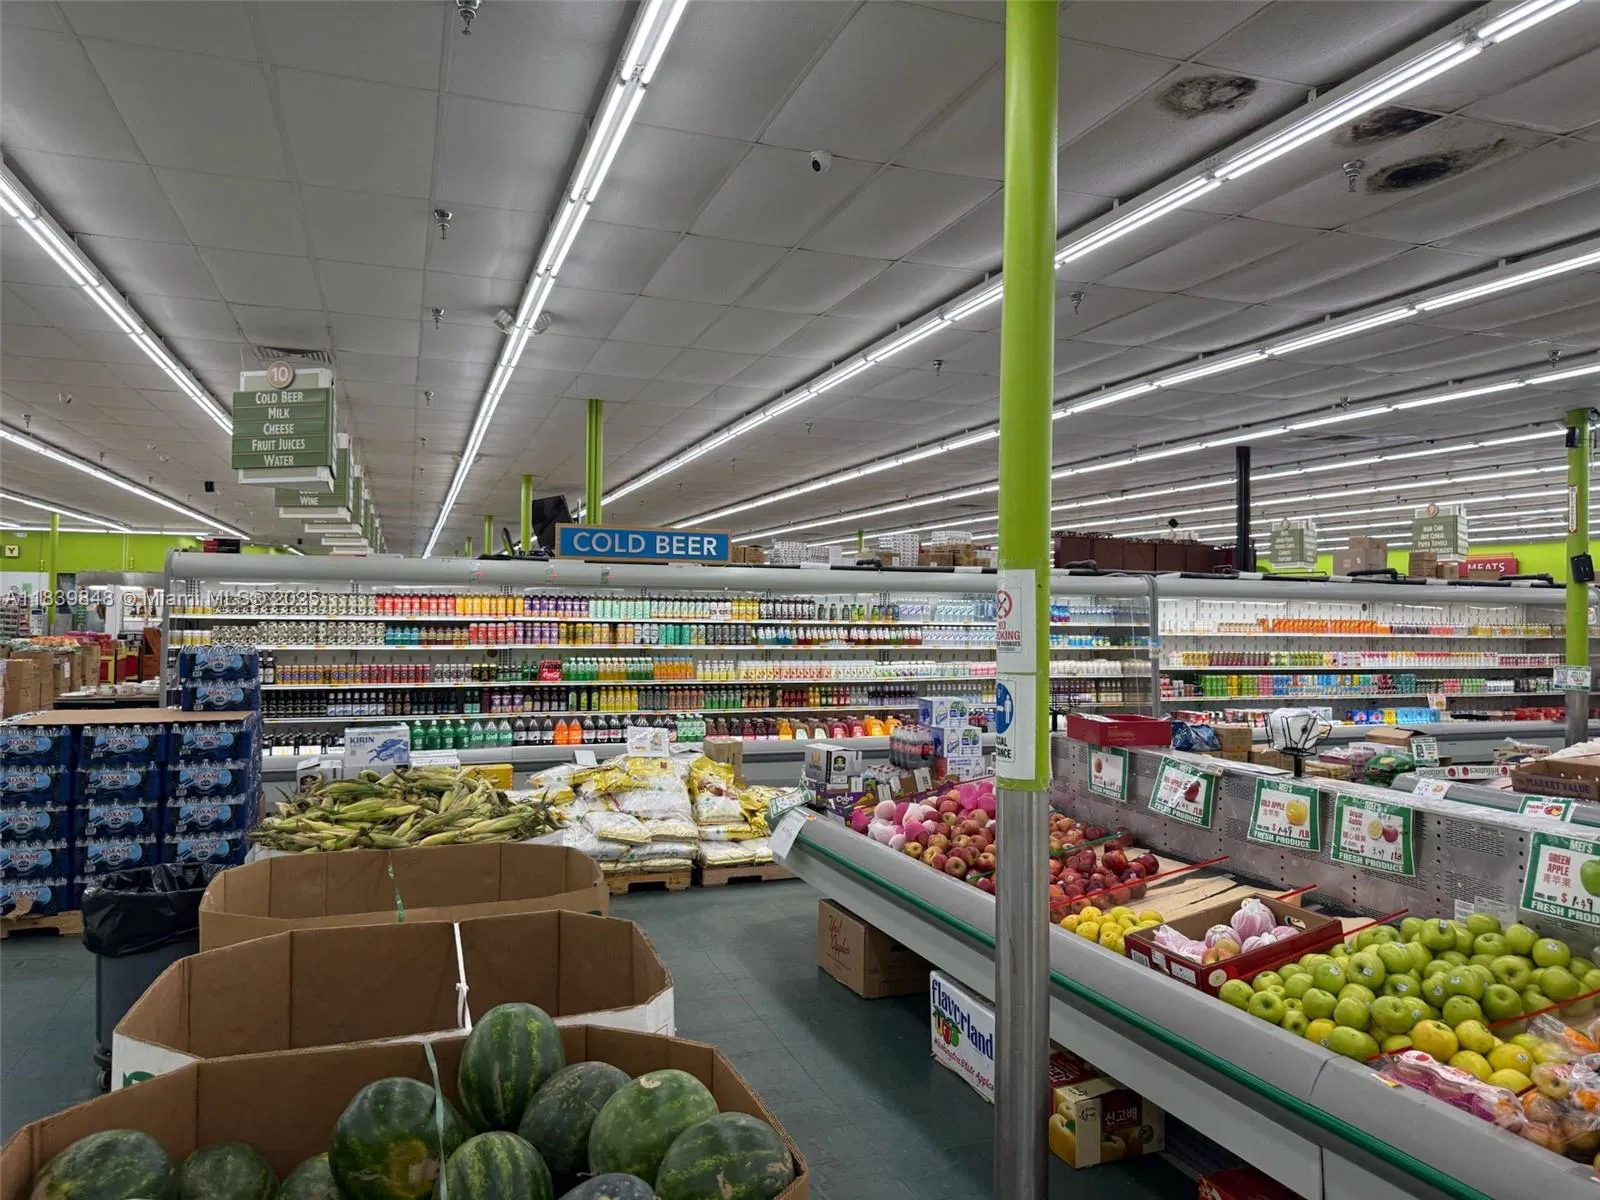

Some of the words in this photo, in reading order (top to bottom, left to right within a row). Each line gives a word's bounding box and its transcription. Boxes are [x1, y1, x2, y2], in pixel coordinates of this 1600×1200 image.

[271, 367, 288, 381] 10
[255, 393, 278, 405] COLD
[281, 391, 304, 403] BEER
[268, 408, 290, 419] MILK
[263, 423, 294, 435] CHEESE
[252, 439, 275, 451] FRUIT
[278, 438, 305, 451] JUICES
[263, 454, 294, 467] WATER
[300, 495, 319, 505] WINE
[573, 532, 646, 553] COLD
[656, 535, 717, 556] BEER
[1467, 562, 1505, 572] MEATS
[349, 736, 376, 744] KIRIN
[1172, 809, 1202, 824] PRODUCE
[1254, 831, 1274, 842] FRESH
[1275, 835, 1311, 848] PRODUCE
[1568, 840, 1594, 854] MEI'S
[1339, 852, 1363, 865] FRESH
[1365, 858, 1404, 873] PRODUCE
[1548, 852, 1571, 866] GREEN
[1547, 863, 1570, 877] APPLE
[1561, 892, 1568, 904] $
[1531, 900, 1564, 916] FRESH
[931, 979, 994, 1061] flavorland
[1104, 1107, 1138, 1126] 신고배
